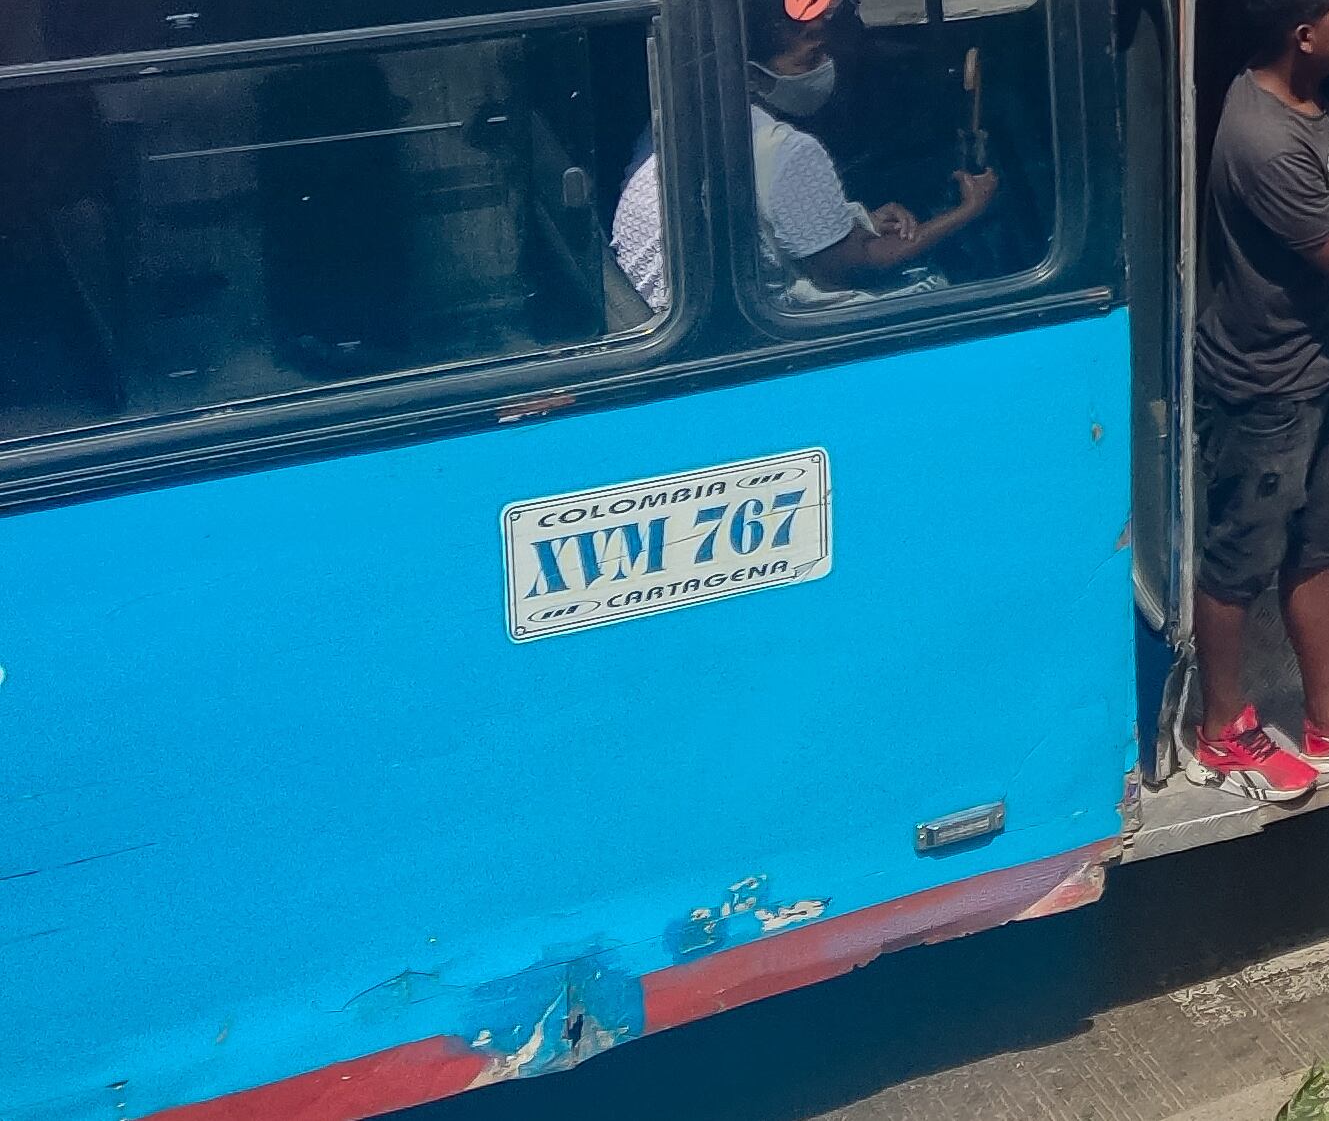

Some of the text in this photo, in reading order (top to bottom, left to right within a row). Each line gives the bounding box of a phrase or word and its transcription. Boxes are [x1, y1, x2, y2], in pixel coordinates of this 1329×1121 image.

[537, 481, 727, 528] COLOMBIA
[523, 488, 808, 600] XVM 767
[606, 560, 789, 608] CARTAGENA
